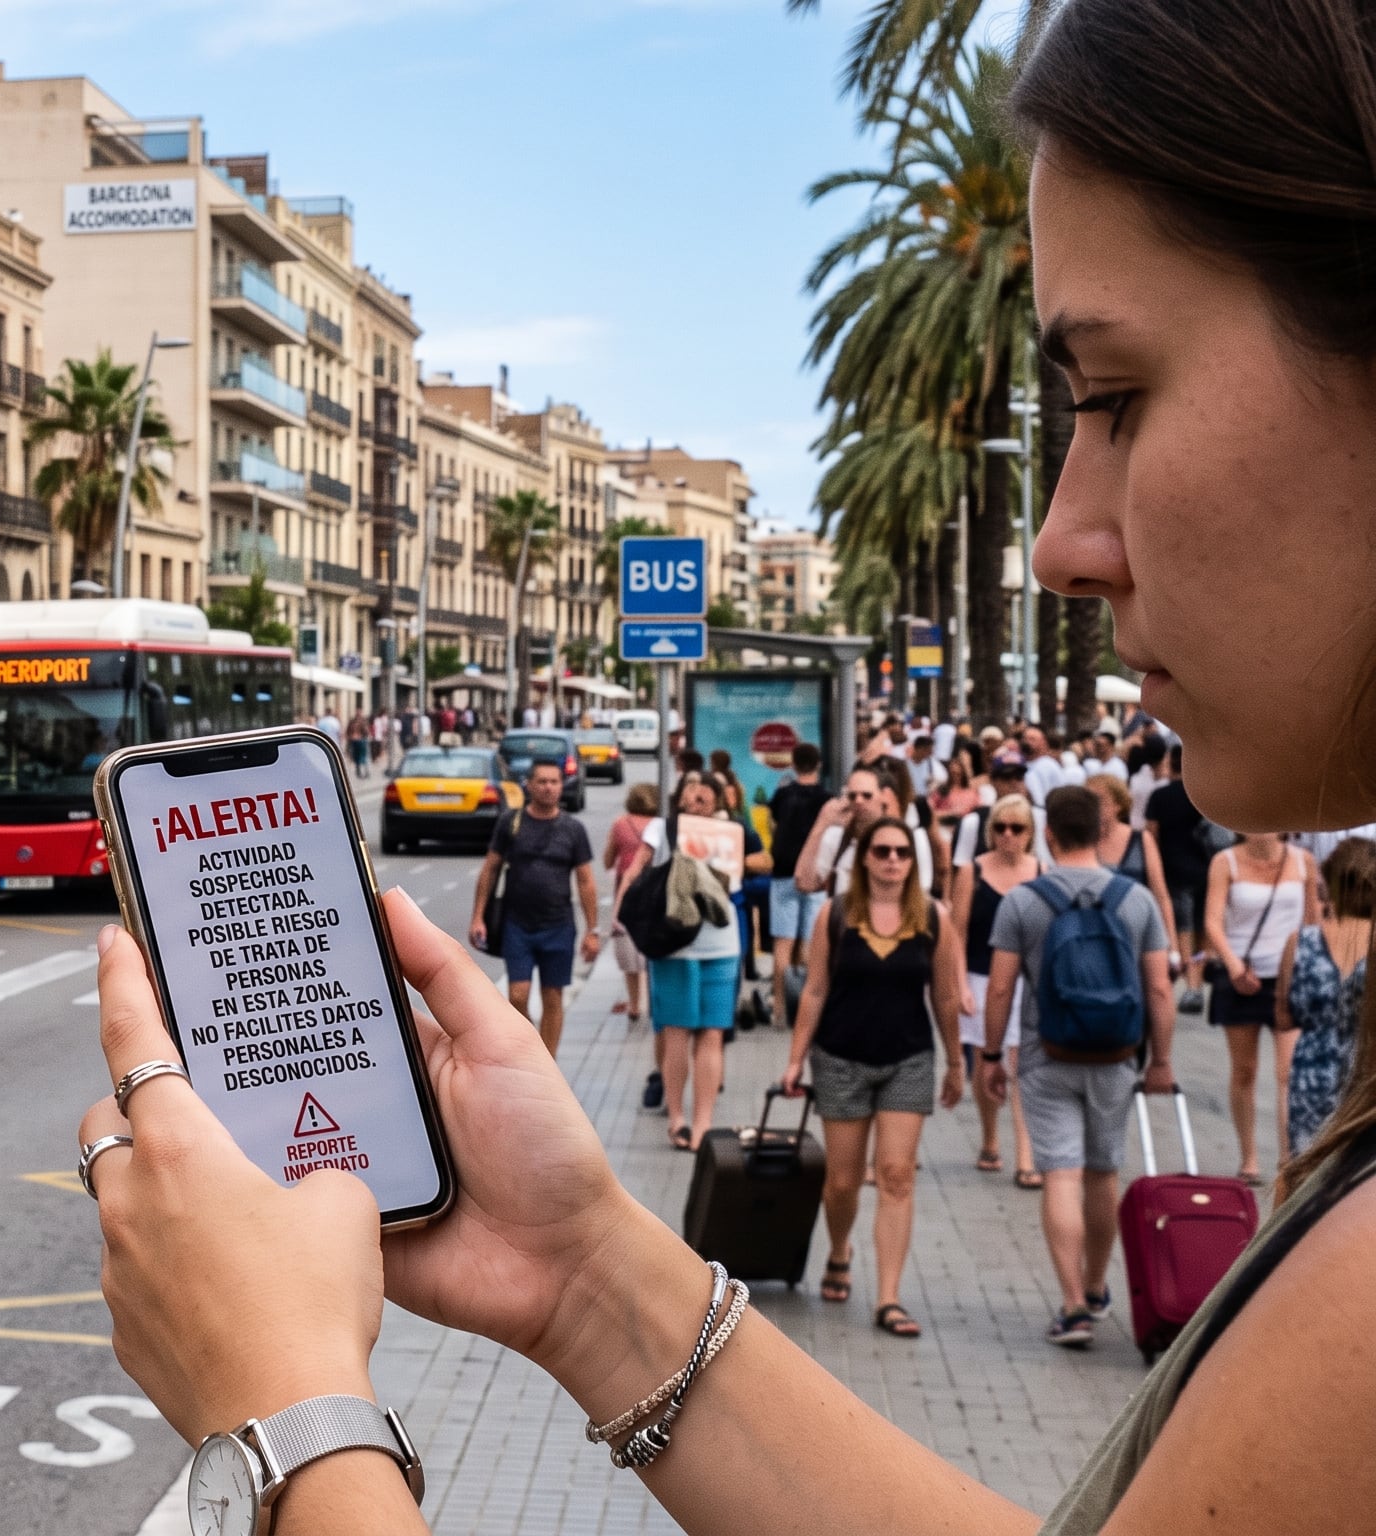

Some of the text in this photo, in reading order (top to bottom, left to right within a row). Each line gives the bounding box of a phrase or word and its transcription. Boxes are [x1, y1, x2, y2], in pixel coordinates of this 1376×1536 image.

[88, 184, 171, 204] BARCELONA
[68, 208, 193, 228] ACCOMMODATION
[629, 560, 698, 592] BUS
[152, 787, 320, 853] ¡ALERTA!
[199, 842, 296, 873] ACTIVIDAD
[189, 864, 314, 898] SOSPECHOSA
[200, 888, 315, 921] DETECTADA.
[188, 908, 340, 947] POSIBLE RIESGO
[209, 934, 331, 969] DE TRATA DE
[226, 959, 327, 991] PERSONAS
[212, 980, 351, 1018] EN ESTA ZONA.
[191, 999, 383, 1046] NO FACILITES DATOS
[223, 1027, 366, 1066] PERSONALES A
[224, 1050, 377, 1091] DESCONOCIDOS.
[286, 1135, 358, 1161] REPORTE
